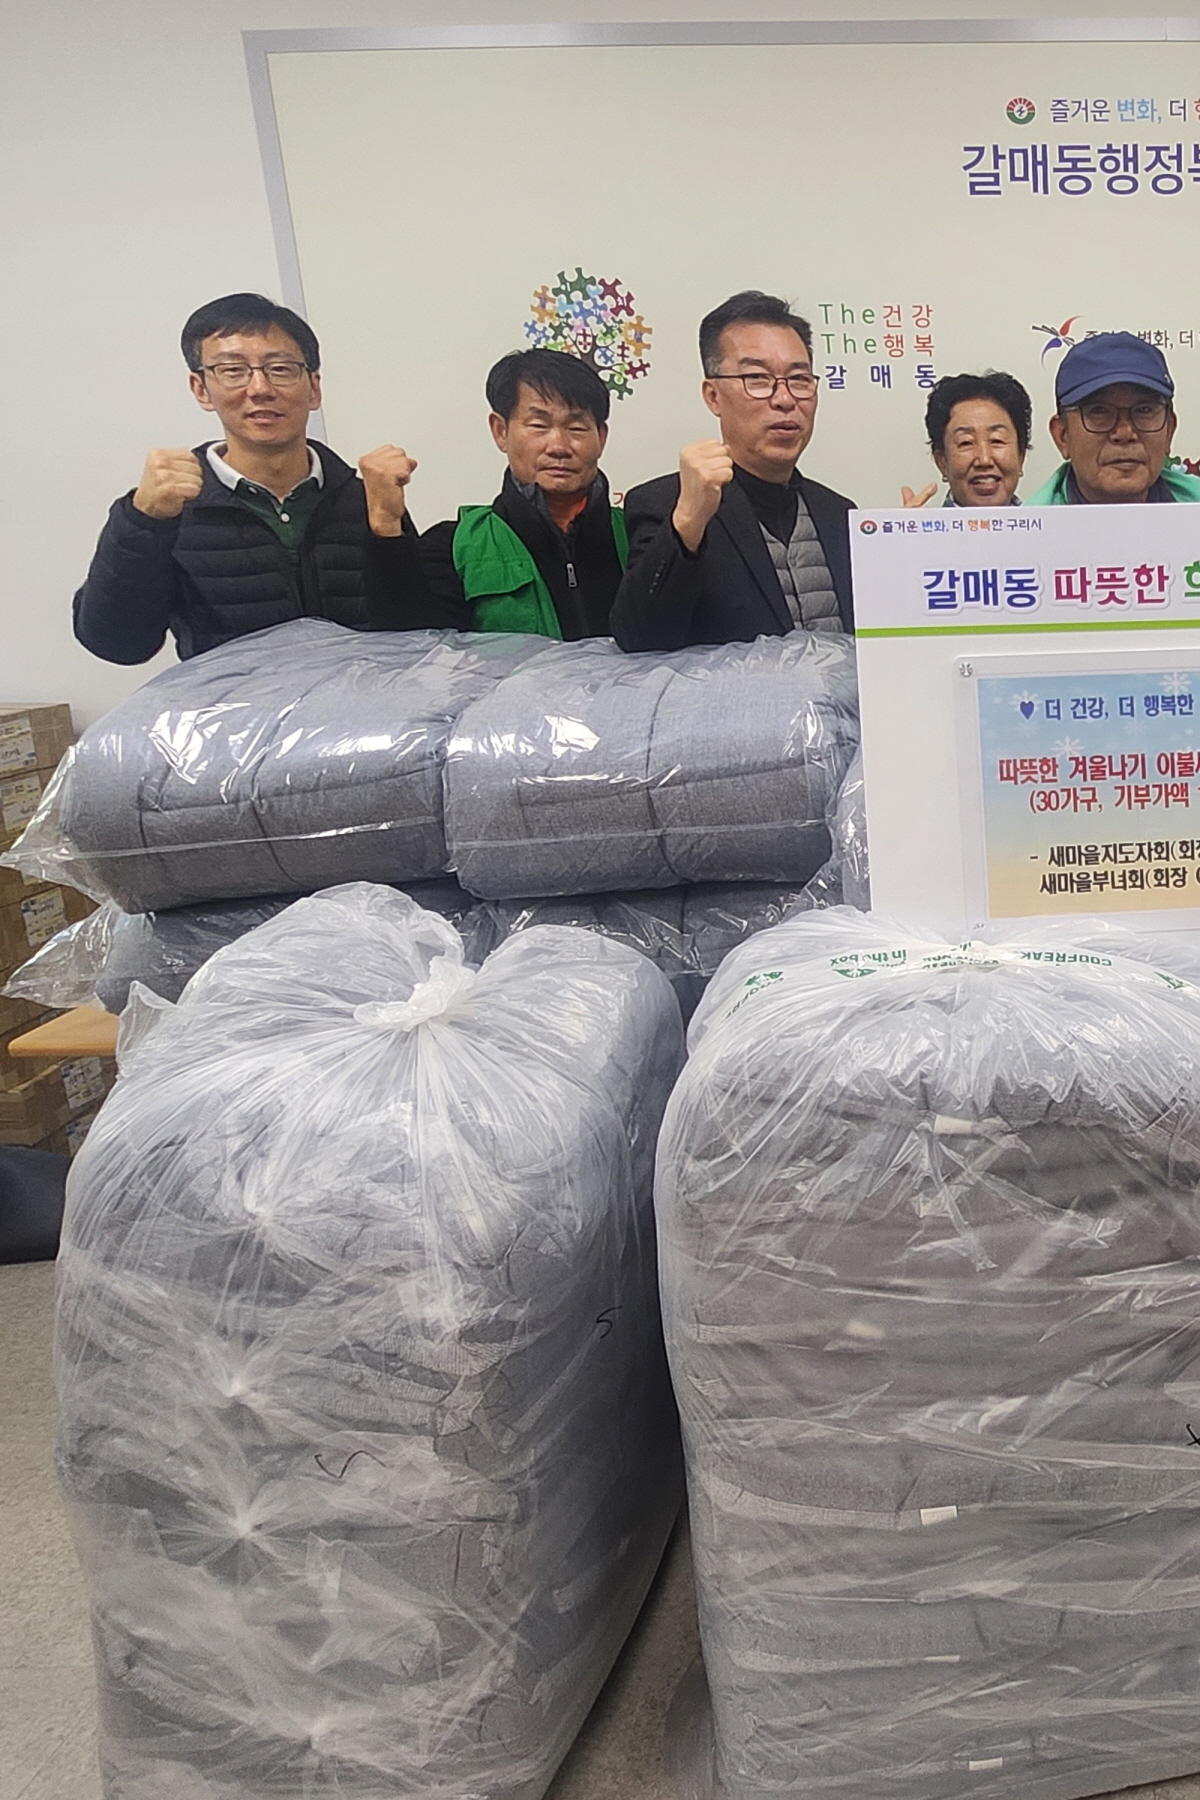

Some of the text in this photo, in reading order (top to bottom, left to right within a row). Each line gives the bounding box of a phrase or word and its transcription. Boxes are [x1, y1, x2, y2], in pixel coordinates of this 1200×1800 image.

[1049, 98, 1111, 123] 즐거운
[1116, 97, 1162, 125] 변화,
[1169, 98, 1188, 123] 더
[1179, 329, 1194, 348] 더
[882, 518, 1042, 534] 즐거운 변화, 더 행복한 구리시
[922, 567, 1040, 610] 갈매동
[1053, 563, 1170, 606] 따뜻한
[1045, 698, 1062, 721] 더
[1070, 696, 1109, 720] 건강,
[1118, 695, 1135, 718] 더
[1143, 693, 1194, 718] 행복한
[998, 756, 1059, 786] 따뜻한
[1068, 753, 1147, 783] 겨울나기
[1029, 786, 1103, 814] (30가구,
[1113, 782, 1190, 811] 기부가액
[1039, 866, 1188, 895] 새마을부녀회(회장
[829, 953, 859, 967] box
[891, 949, 907, 960] in
